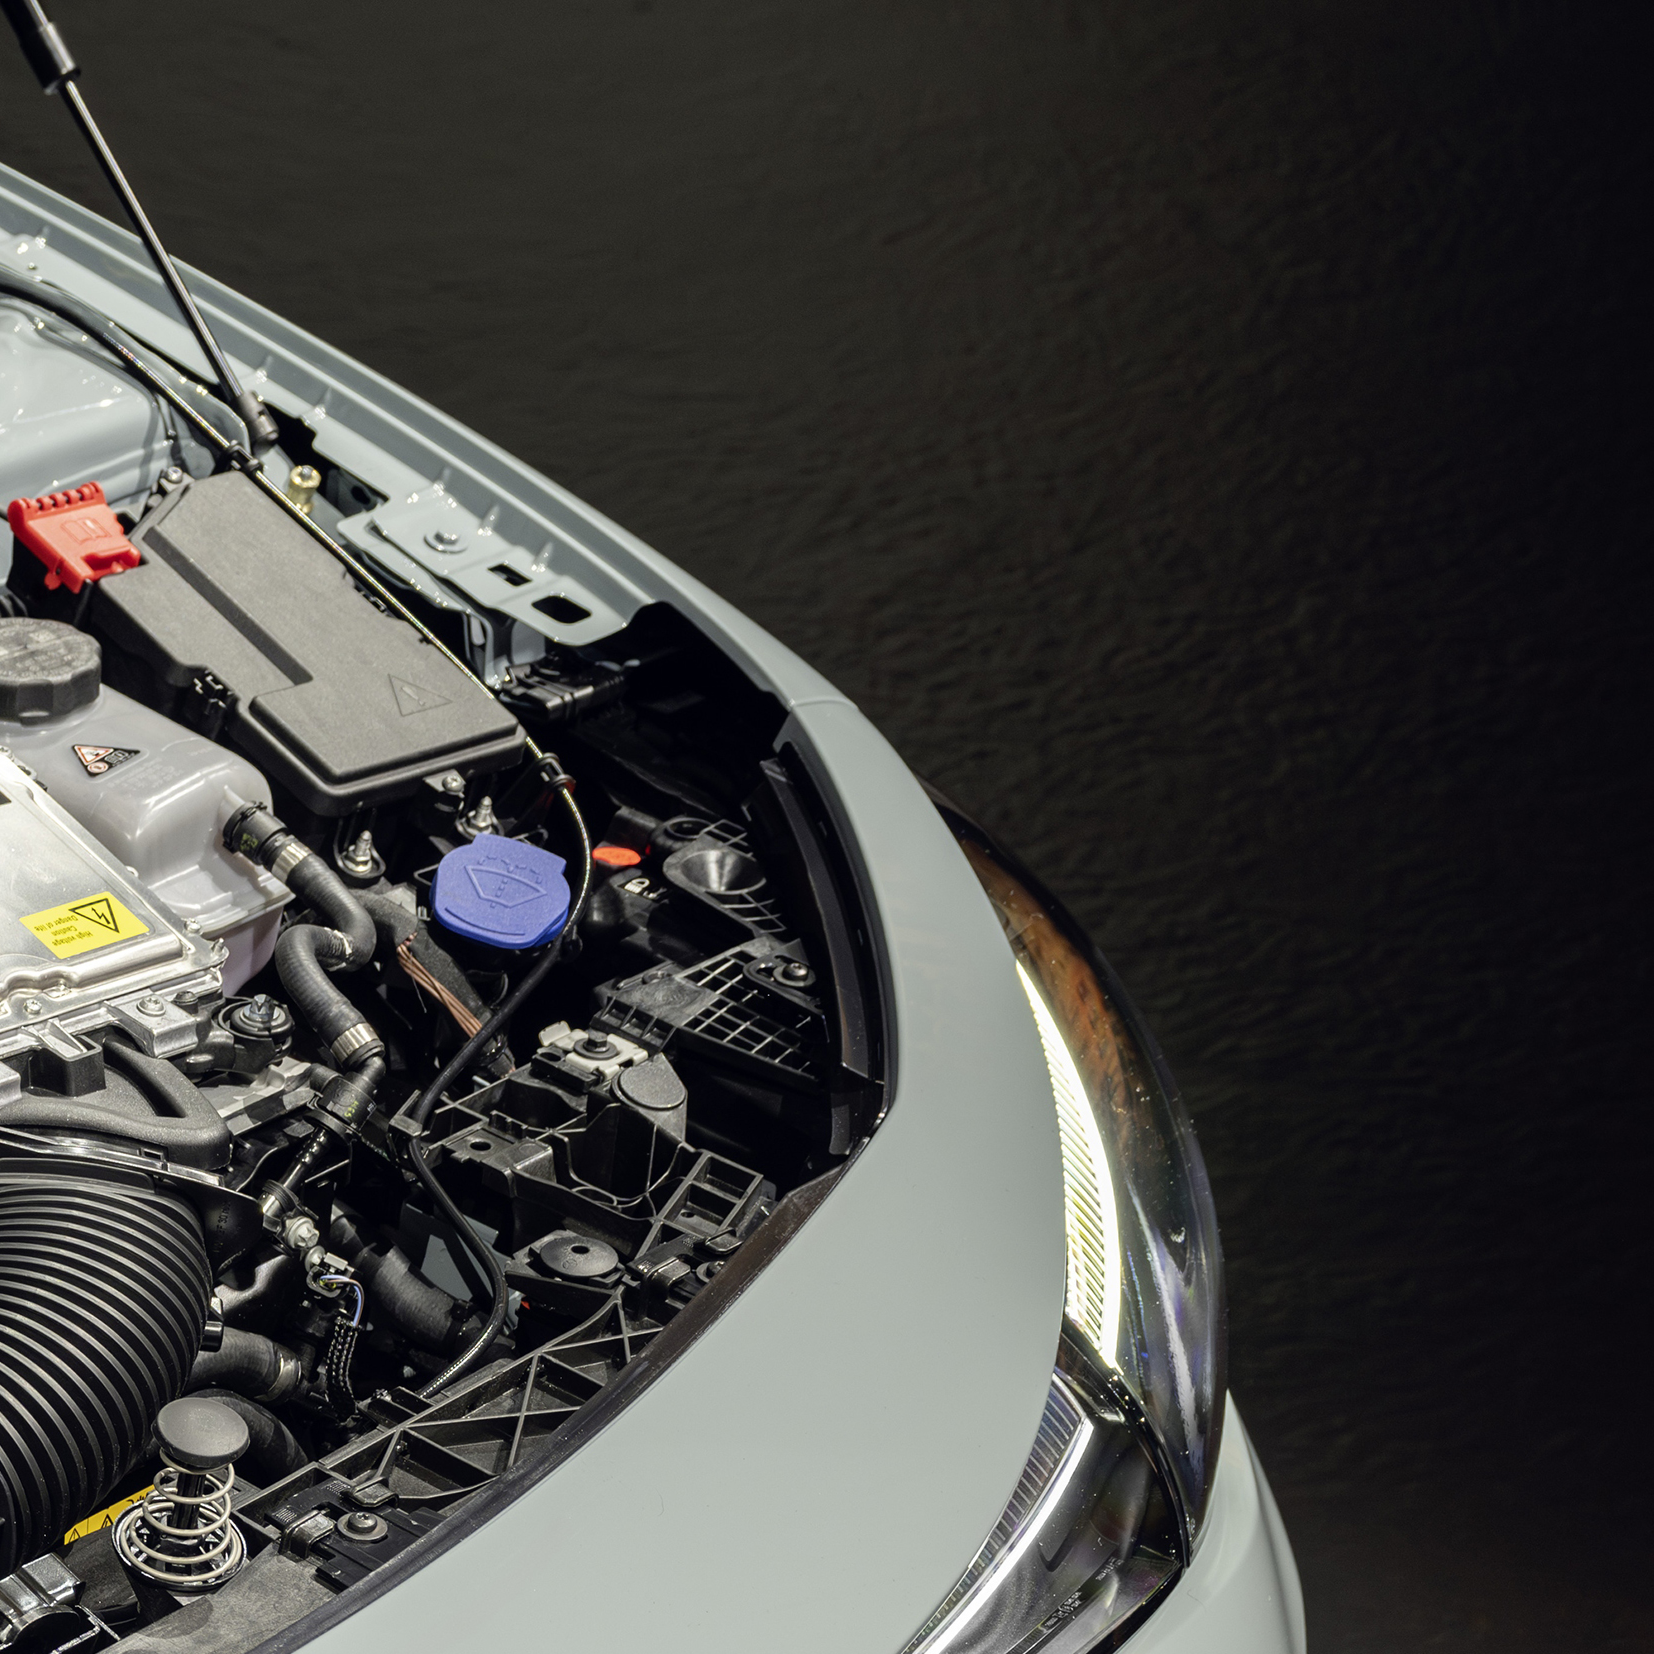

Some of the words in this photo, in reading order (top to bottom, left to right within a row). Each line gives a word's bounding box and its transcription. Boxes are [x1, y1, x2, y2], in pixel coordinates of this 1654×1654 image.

[54, 915, 79, 925] Danger
[33, 924, 47, 932] life
[51, 925, 78, 937] Caution
[76, 930, 94, 941] High
[51, 936, 77, 947] voltage
